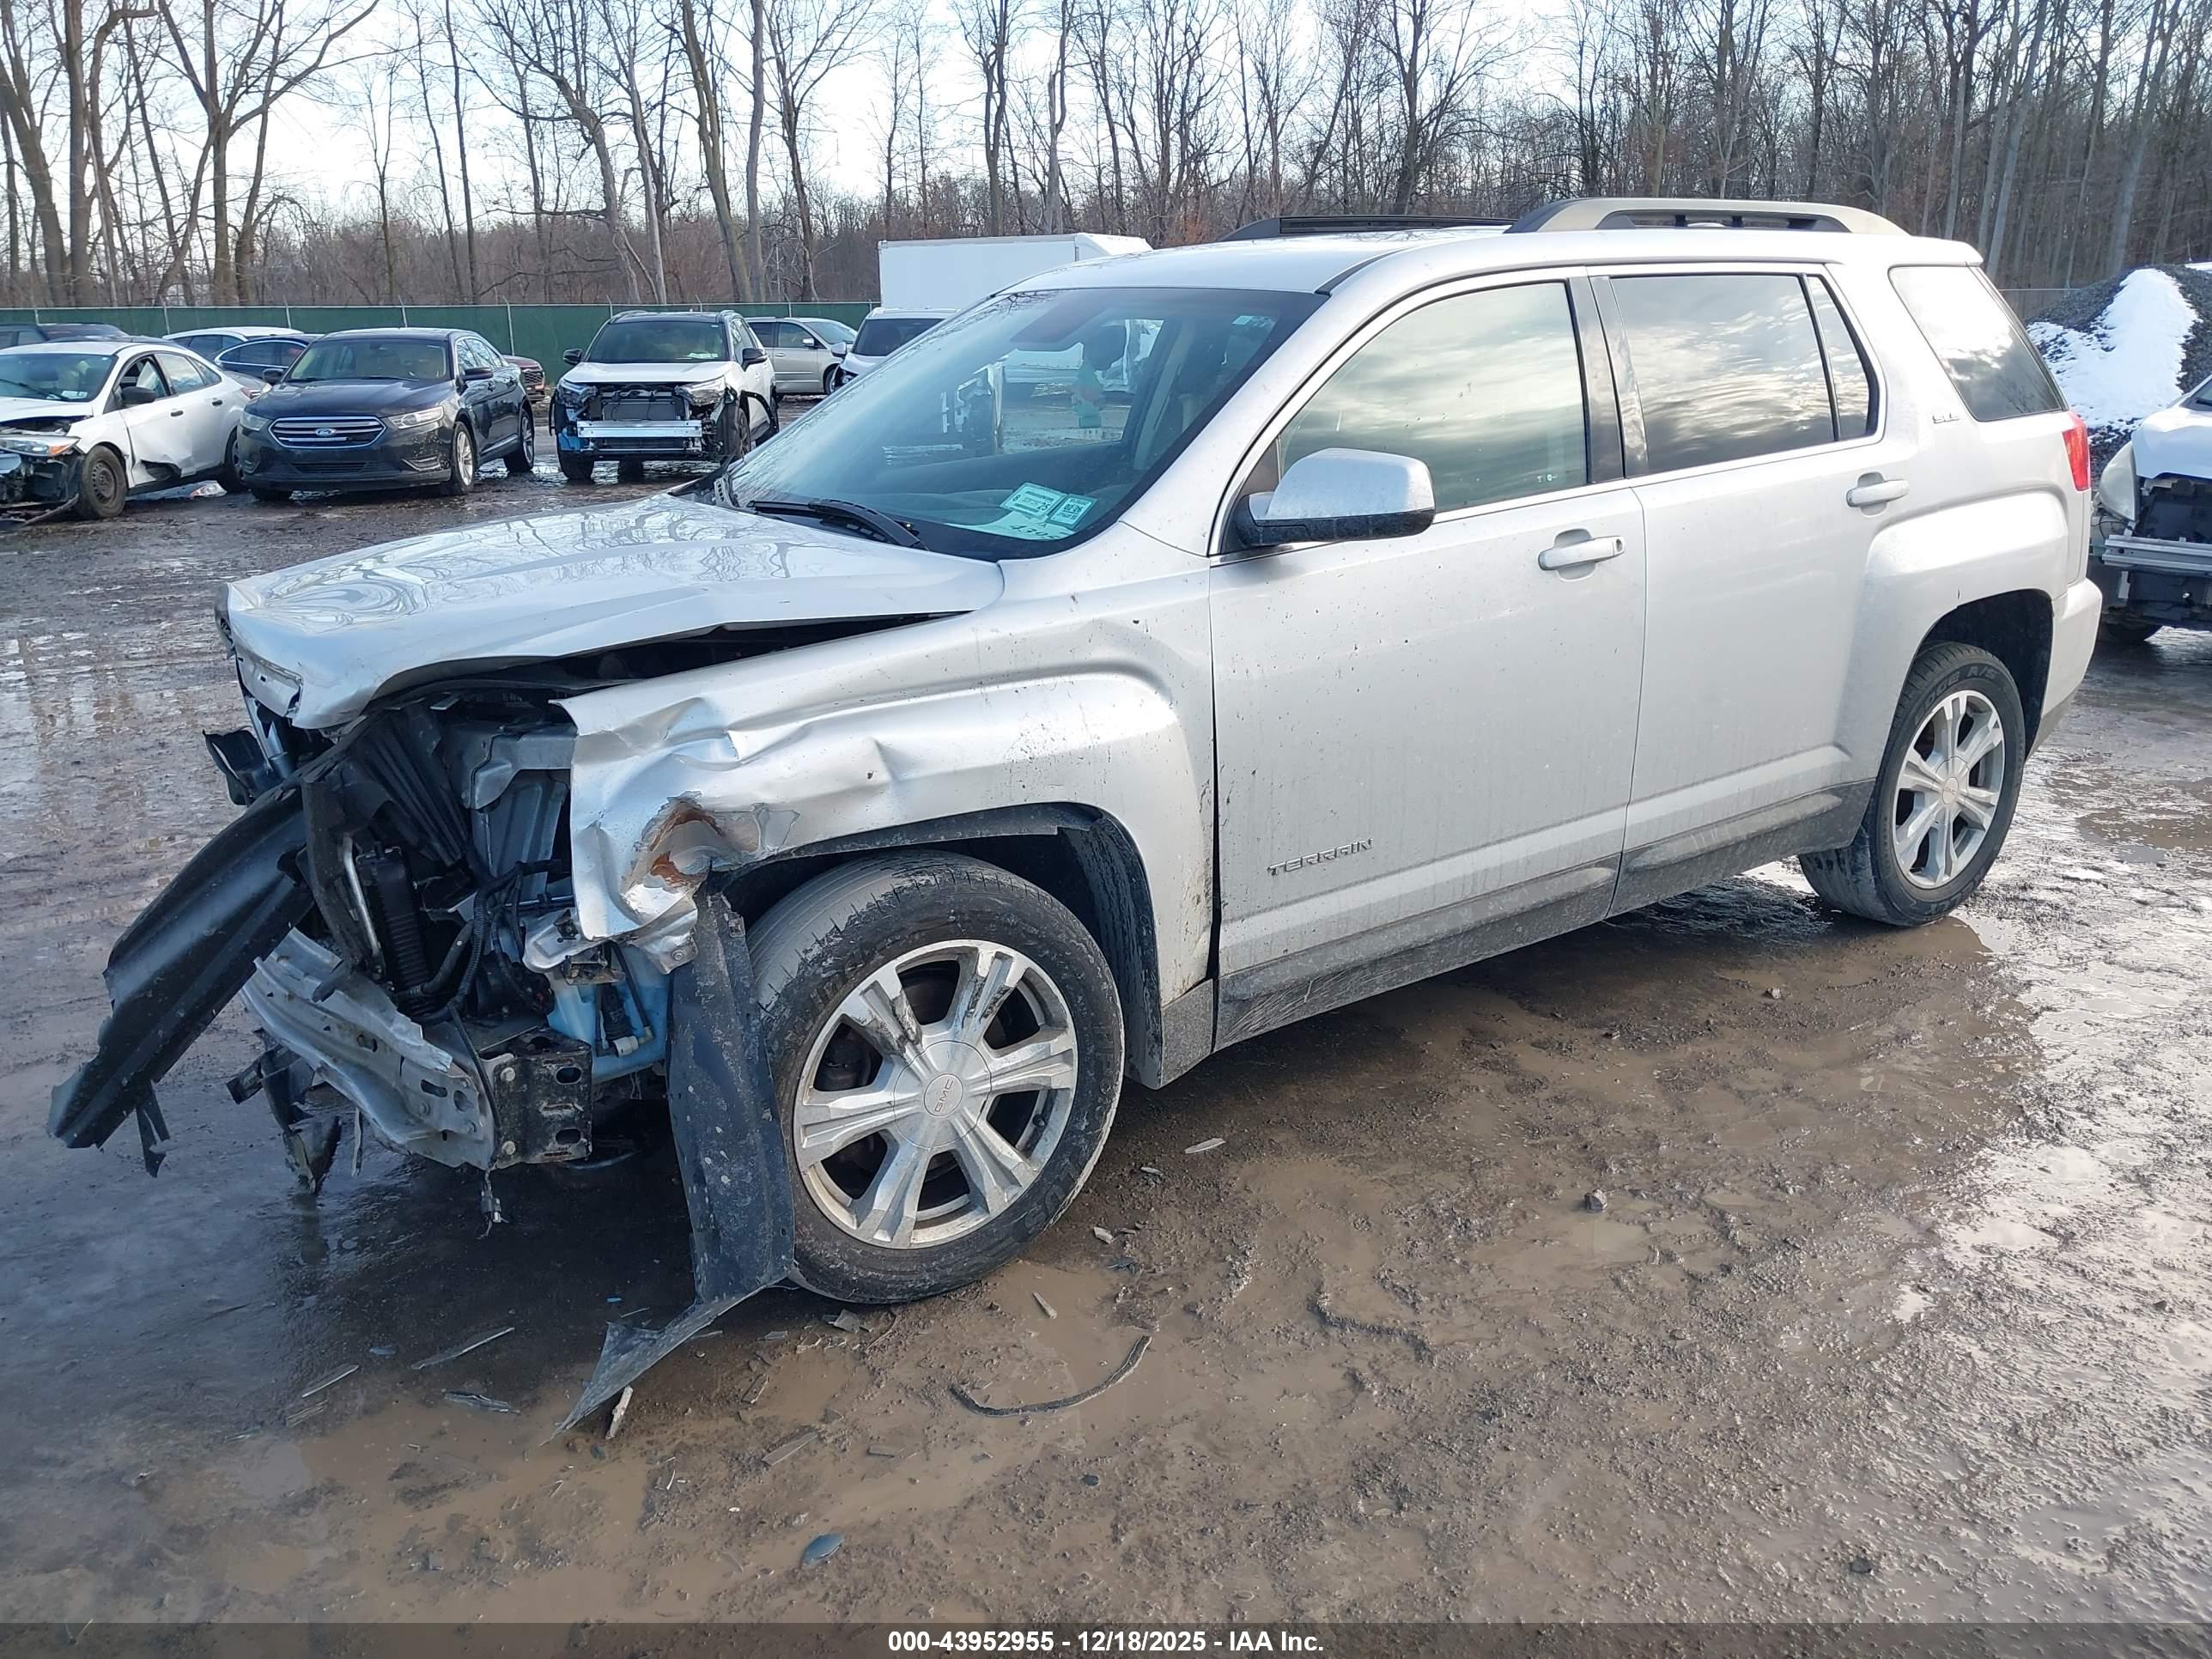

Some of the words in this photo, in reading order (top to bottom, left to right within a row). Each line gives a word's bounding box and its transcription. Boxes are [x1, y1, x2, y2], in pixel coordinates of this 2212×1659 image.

[1037, 501, 1051, 511] 25
[1267, 838, 1374, 876] TERRAIN
[934, 1078, 955, 1113] GMC
